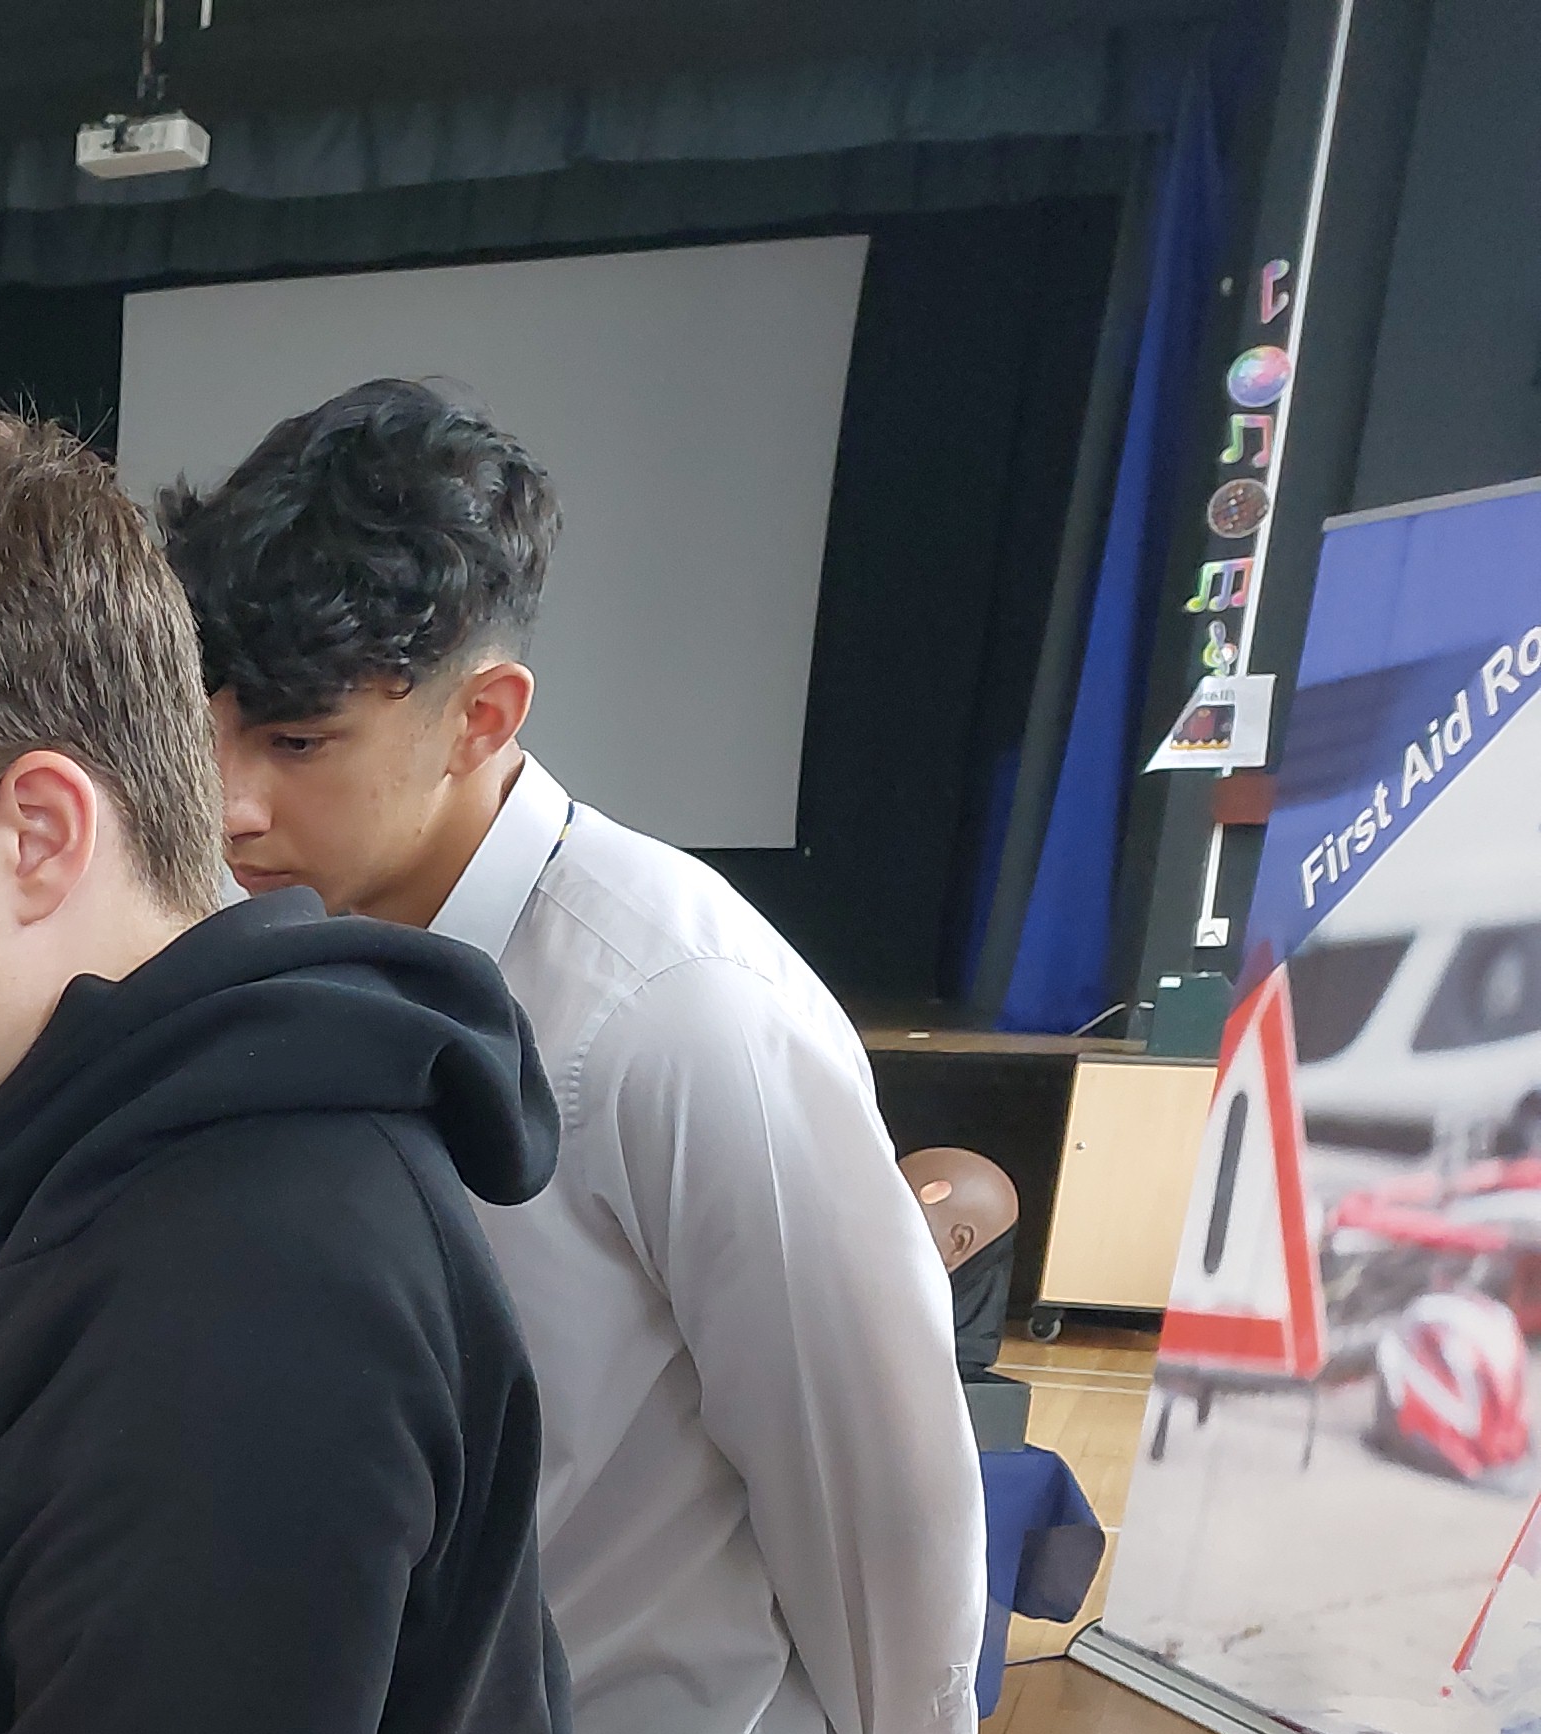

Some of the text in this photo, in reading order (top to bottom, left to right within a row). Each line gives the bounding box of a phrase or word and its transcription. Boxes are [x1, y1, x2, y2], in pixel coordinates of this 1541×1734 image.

[1300, 625, 1541, 909] First Aid Ro
